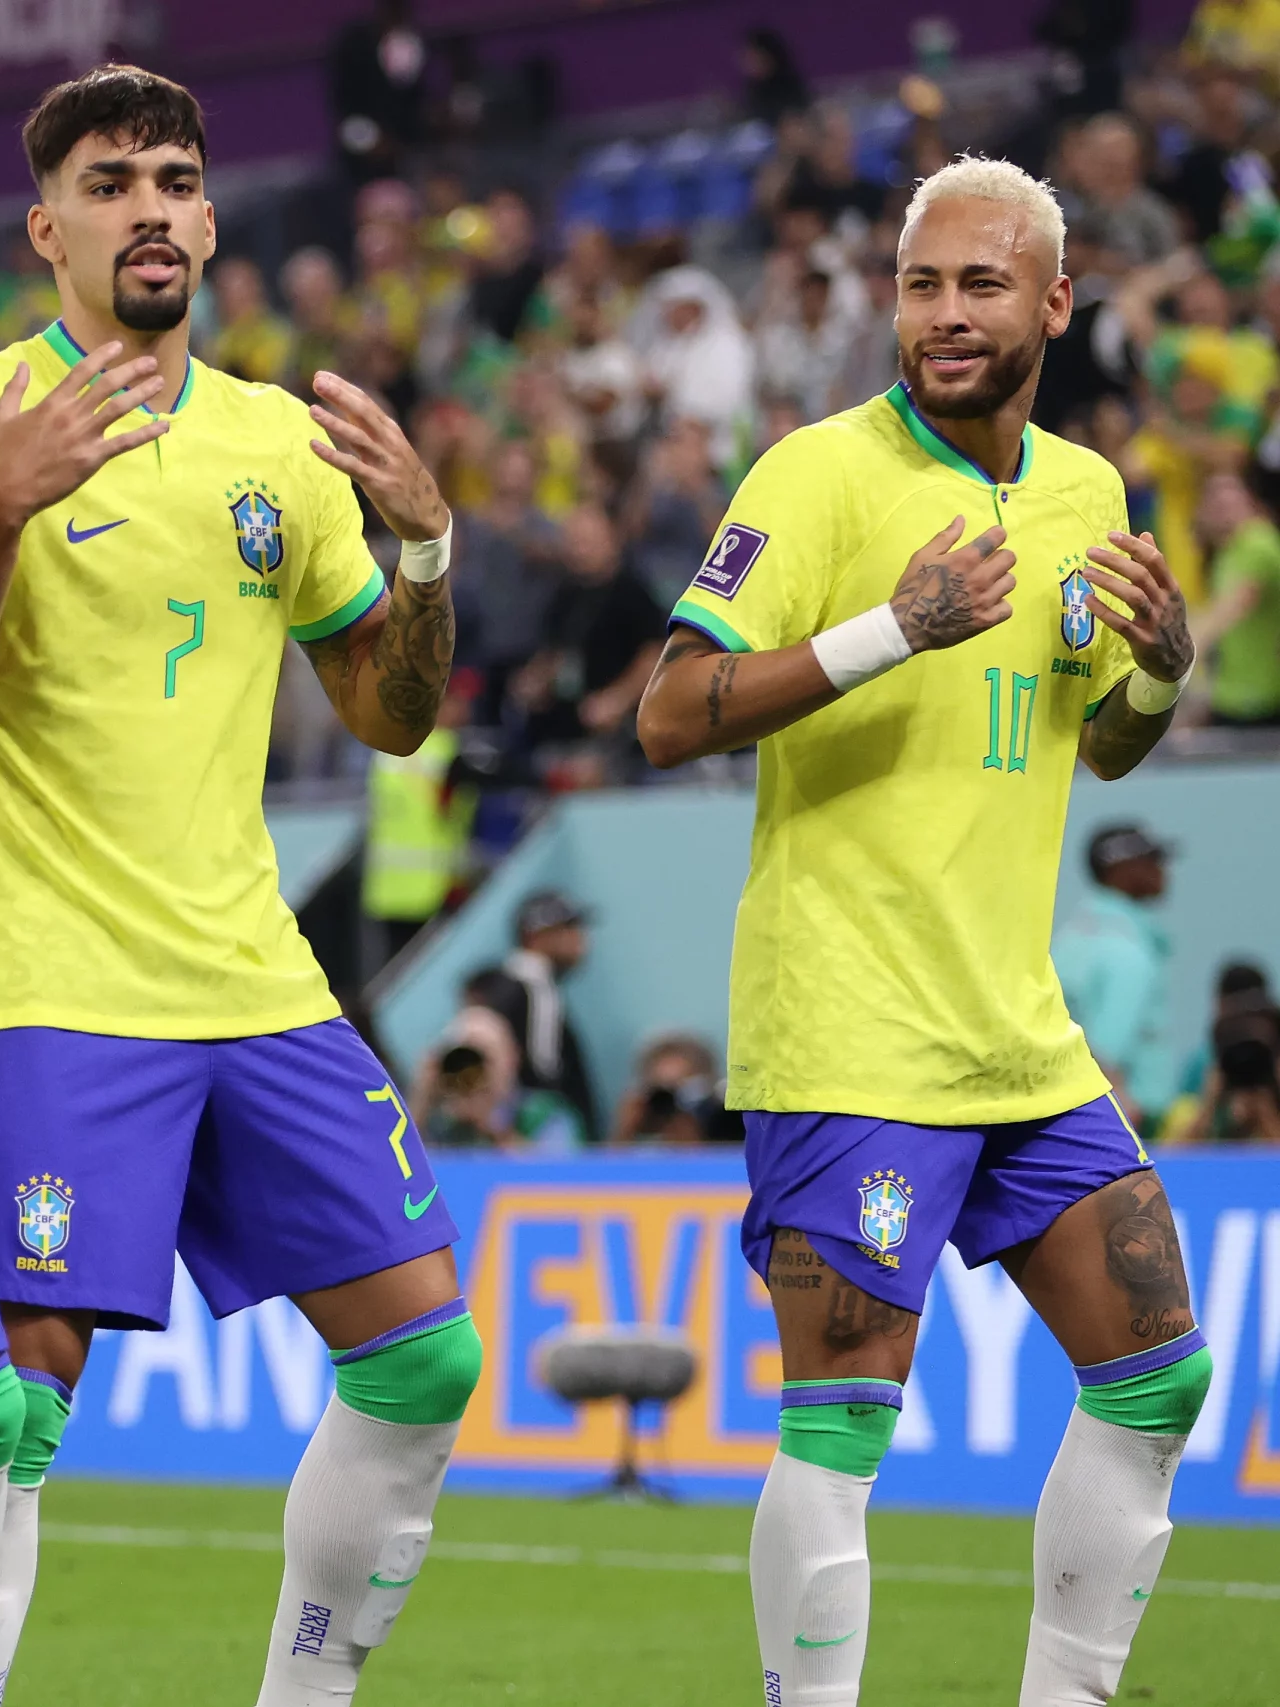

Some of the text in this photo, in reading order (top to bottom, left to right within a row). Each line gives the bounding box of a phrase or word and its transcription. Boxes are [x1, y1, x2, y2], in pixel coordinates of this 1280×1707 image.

[249, 526, 267, 538] CBF
[239, 581, 280, 600] BRASIL
[164, 598, 205, 699] 7
[983, 667, 1039, 775] 10
[363, 1081, 413, 1181] 7
[35, 1214, 54, 1223] CBF
[876, 1208, 894, 1218] CBF
[16, 1256, 68, 1272] BRASIL
[856, 1243, 900, 1269] BRASIL
[292, 1601, 332, 1656] BRASIL
